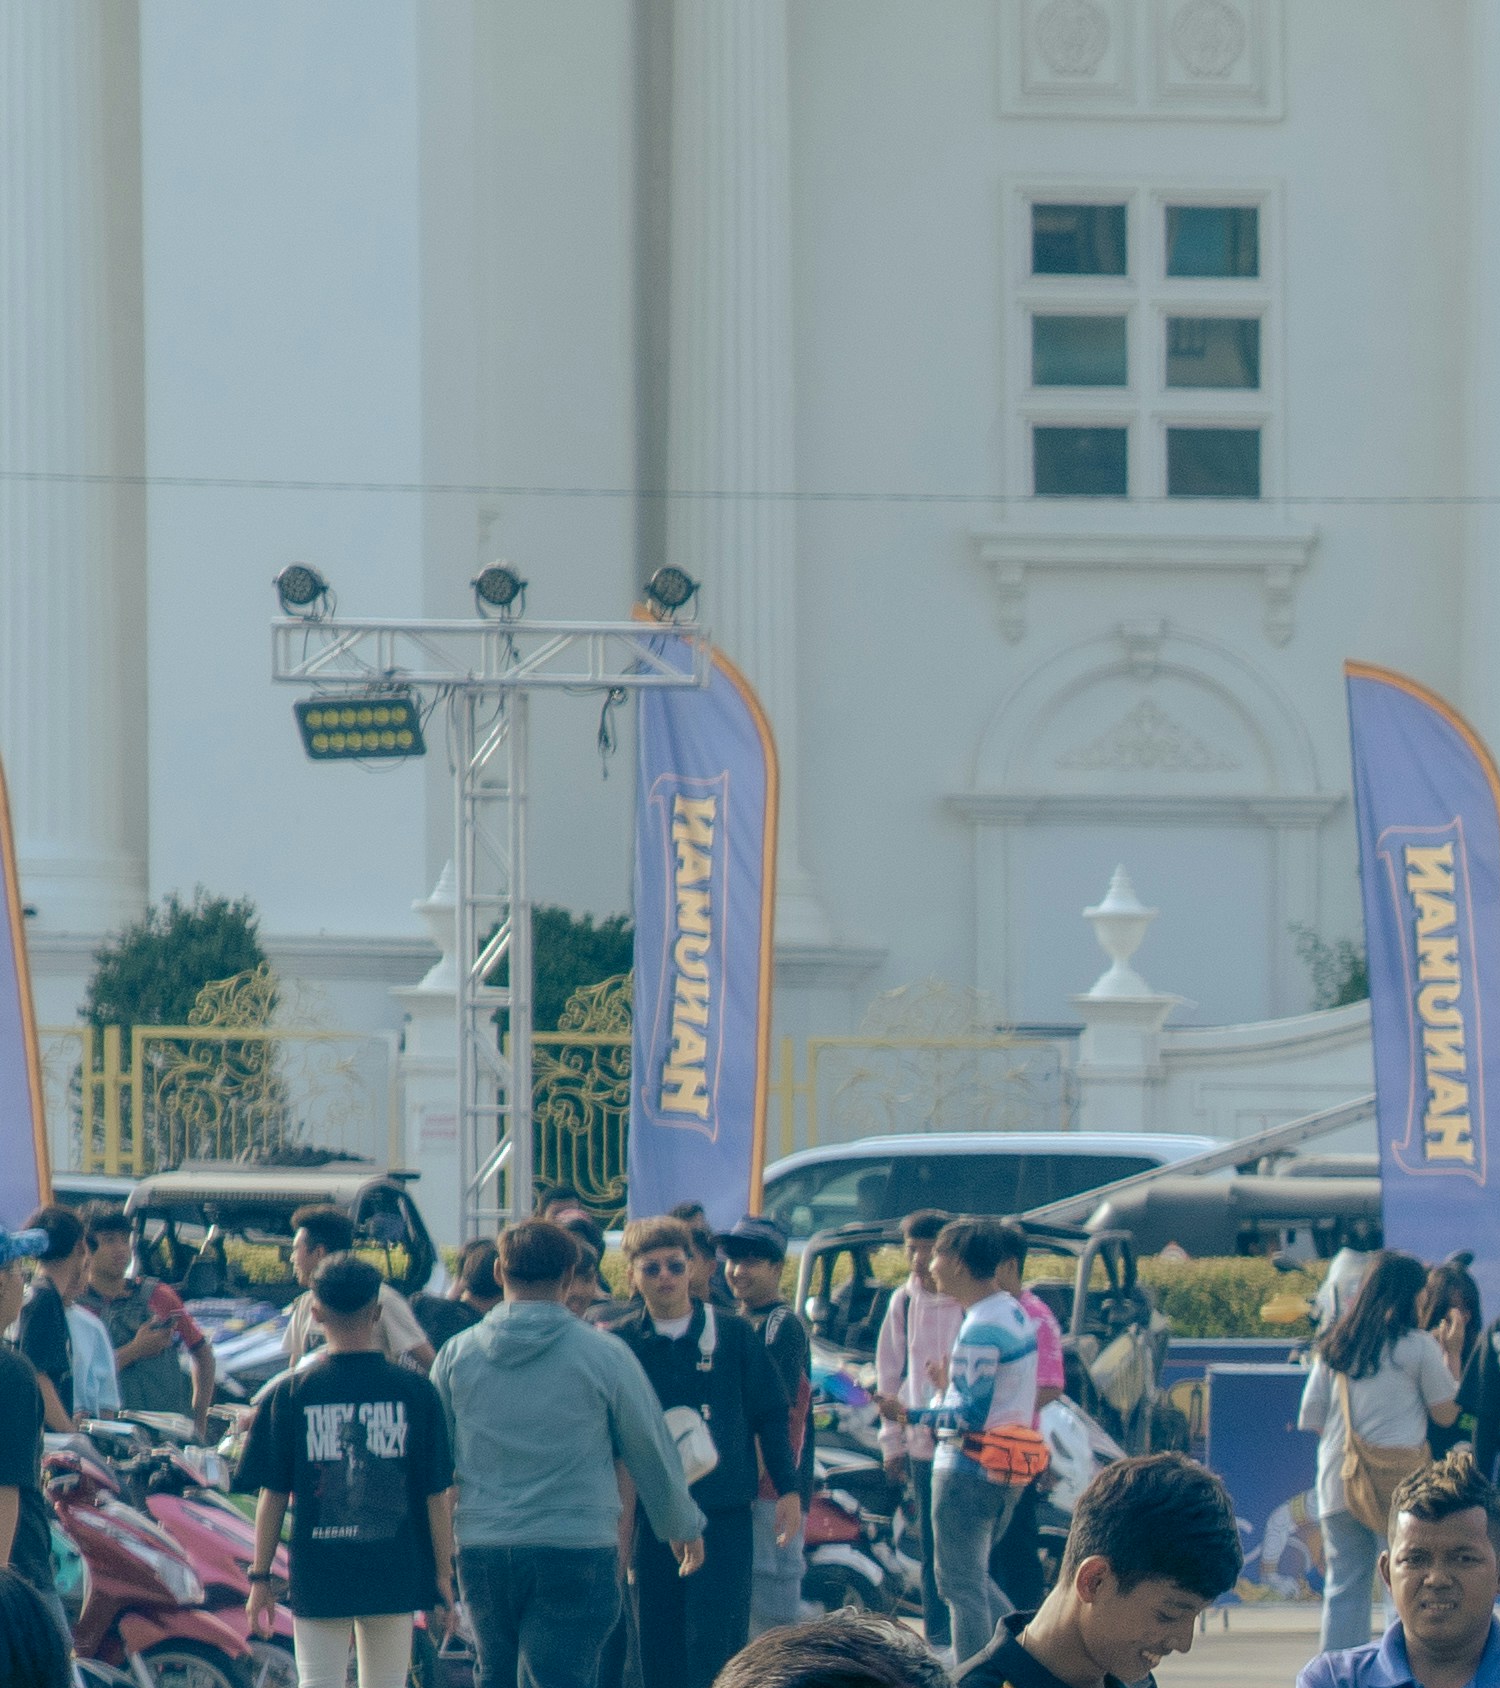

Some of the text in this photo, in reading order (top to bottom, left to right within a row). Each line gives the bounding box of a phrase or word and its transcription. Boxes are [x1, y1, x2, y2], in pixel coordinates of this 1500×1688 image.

[303, 1400, 408, 1433] THEY CALL
[306, 1431, 344, 1462] ME
